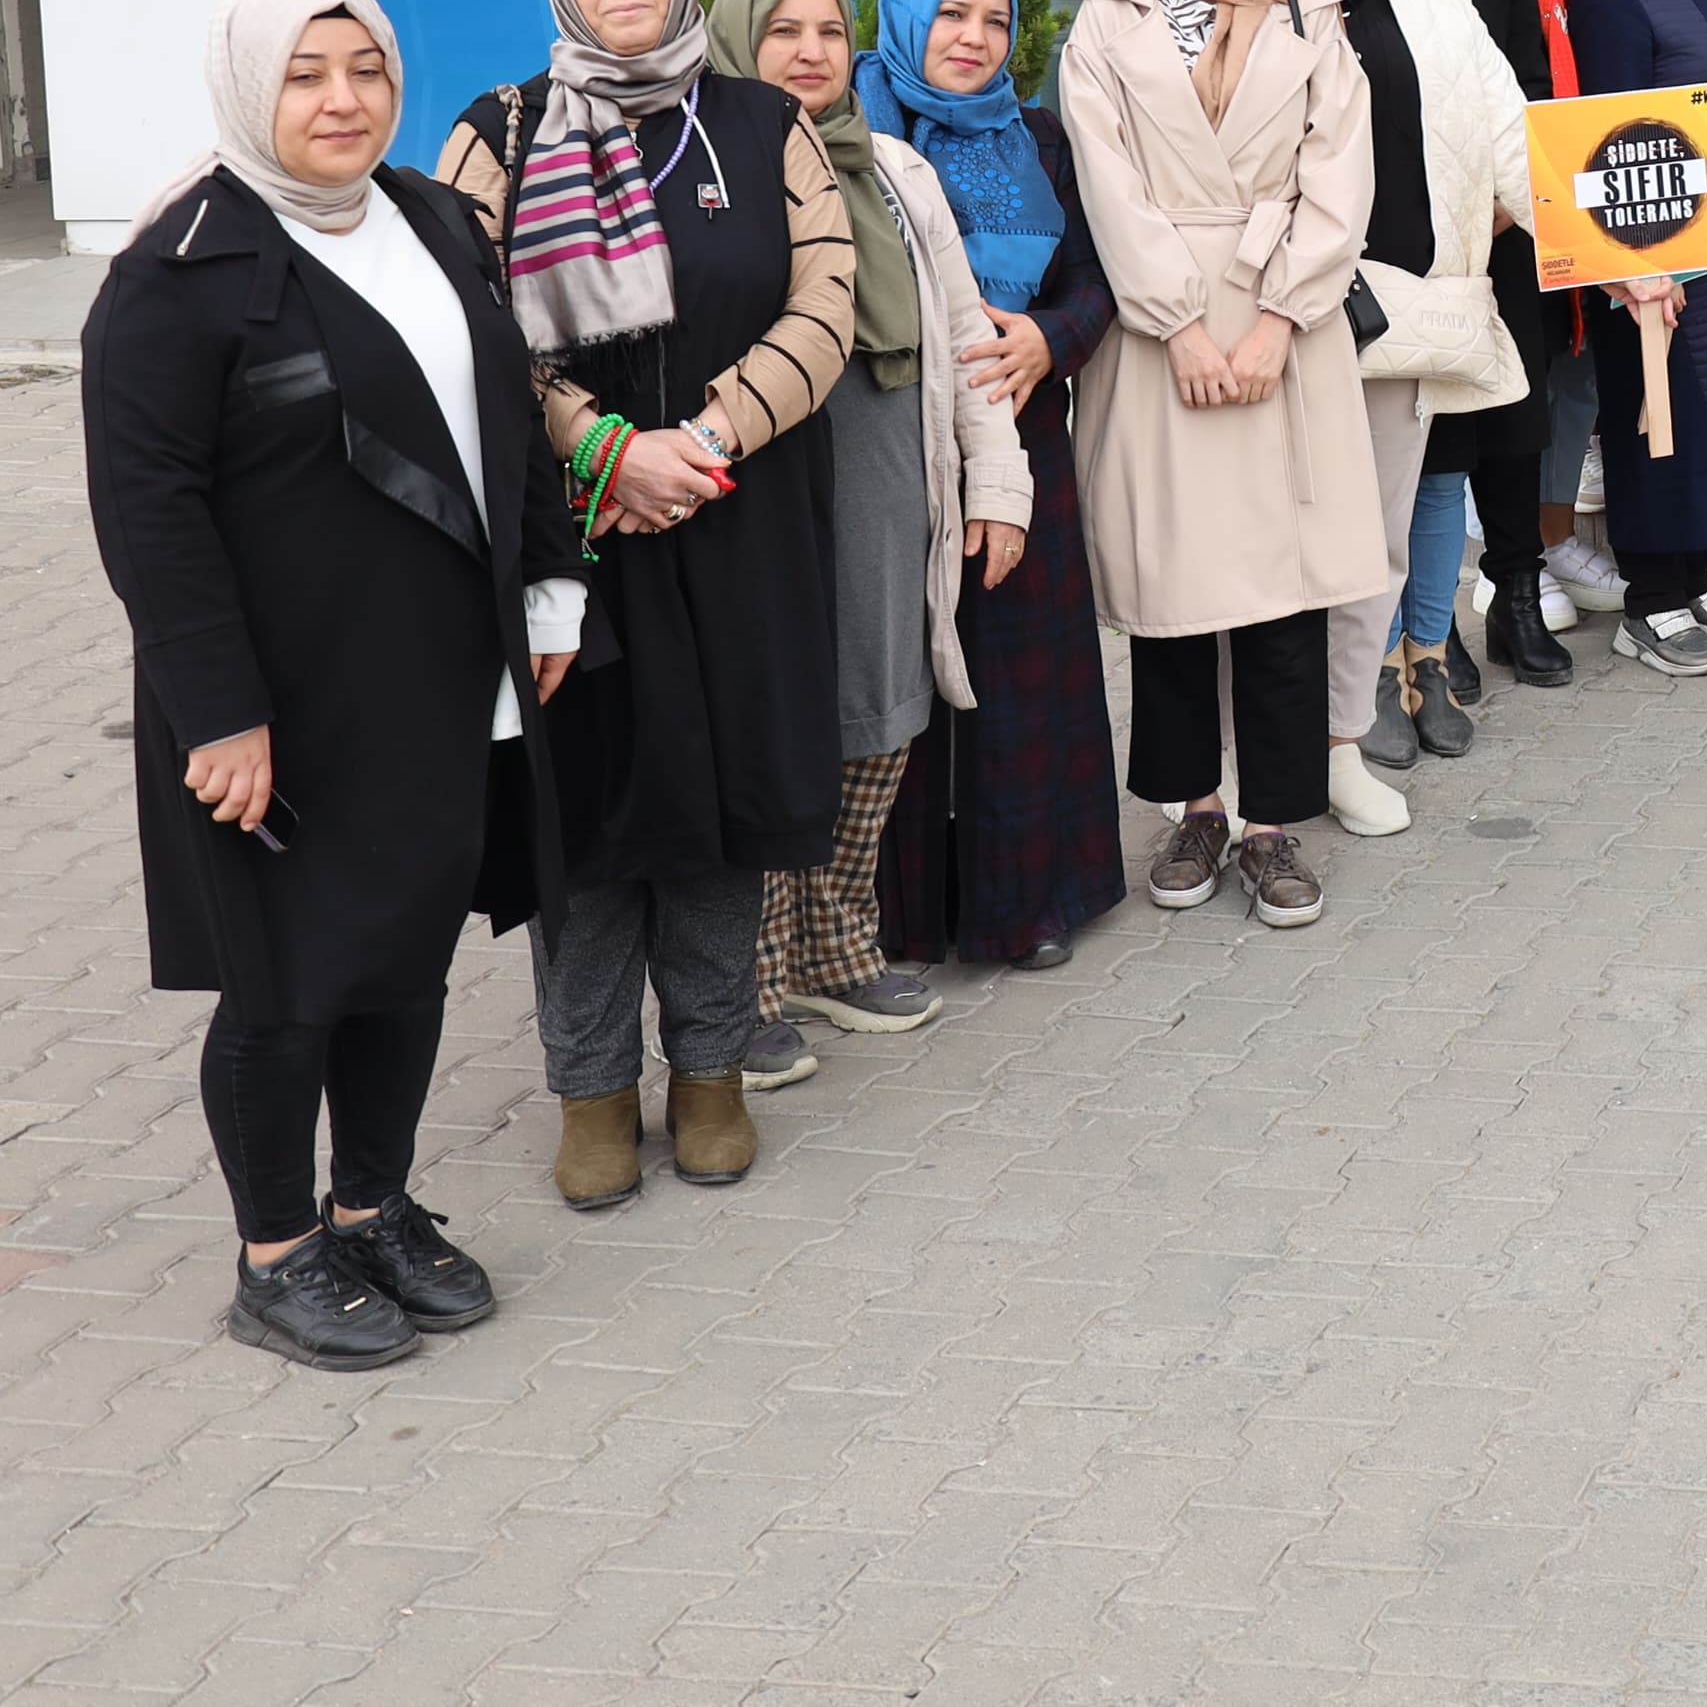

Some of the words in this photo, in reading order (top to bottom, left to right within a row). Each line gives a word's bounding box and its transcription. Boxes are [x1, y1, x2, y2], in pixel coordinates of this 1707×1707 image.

[1607, 138, 1685, 167] ŞİDDETE,
[1603, 162, 1687, 205] SIFIR
[1605, 198, 1693, 228] TOLERANS
